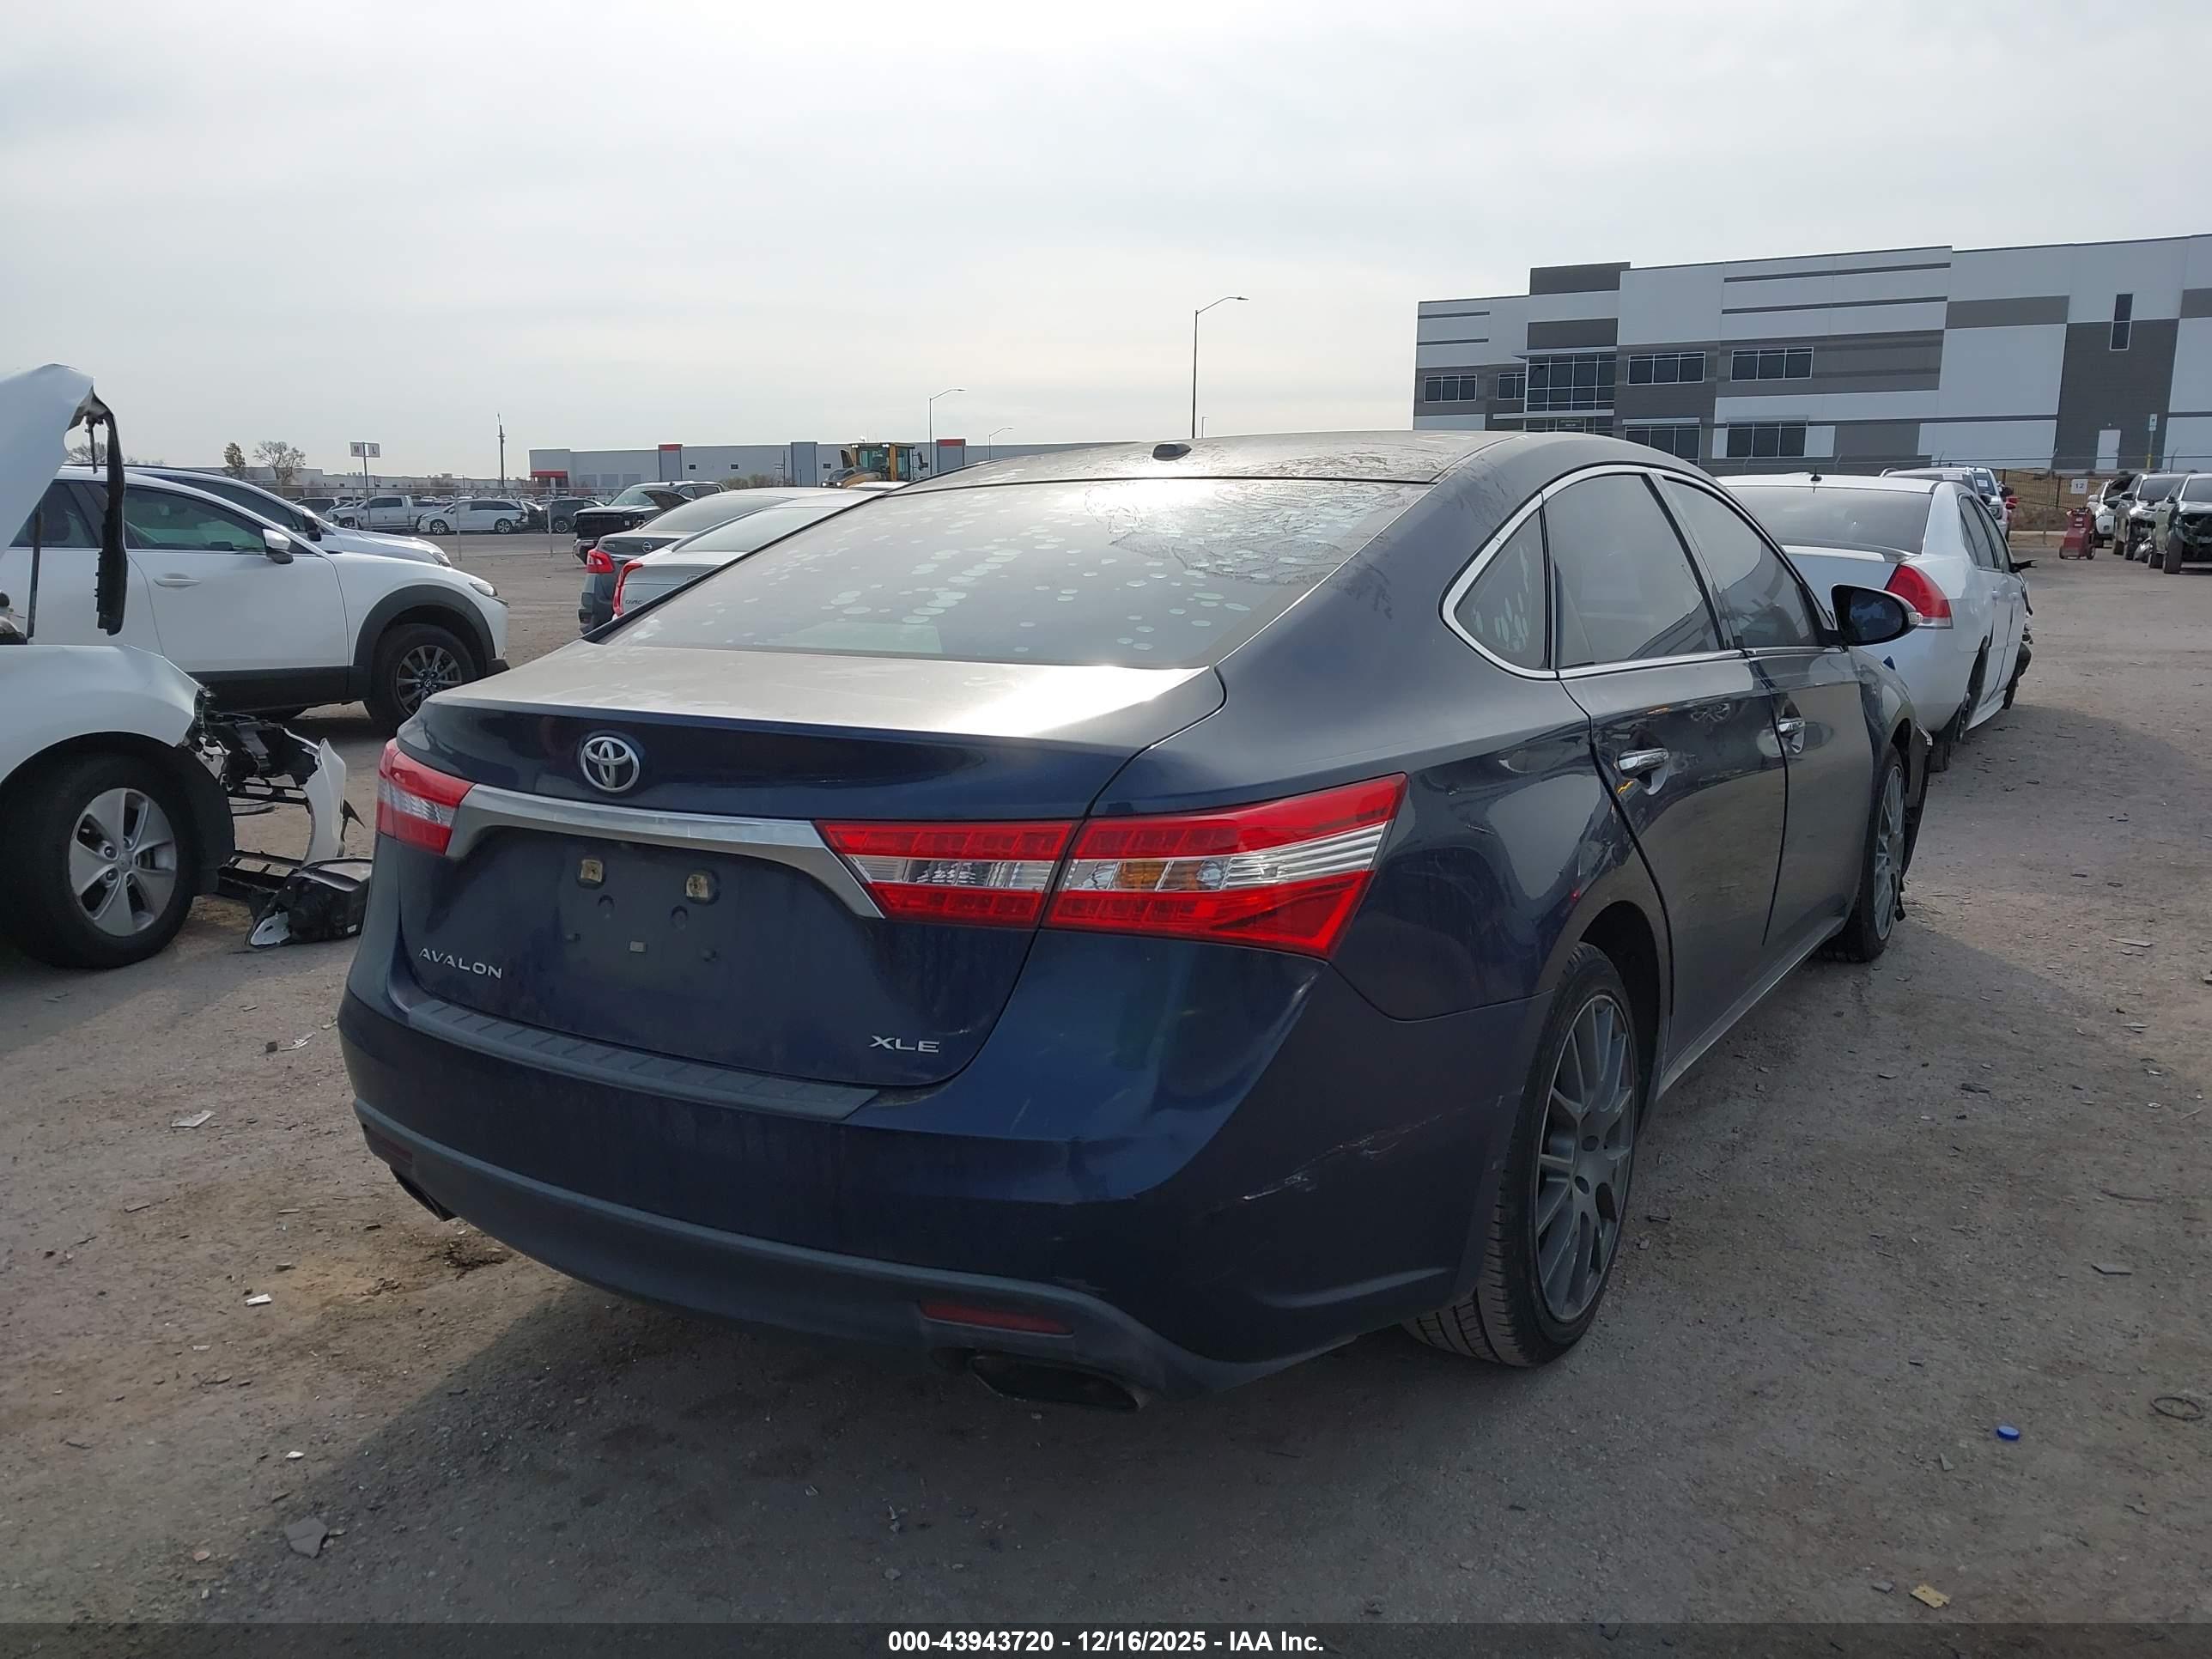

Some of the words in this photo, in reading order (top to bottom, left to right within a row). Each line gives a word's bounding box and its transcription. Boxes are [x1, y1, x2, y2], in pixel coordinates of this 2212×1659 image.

[372, 446, 376, 454] L
[418, 946, 503, 980] AVALON
[870, 1035, 940, 1054] XLE
